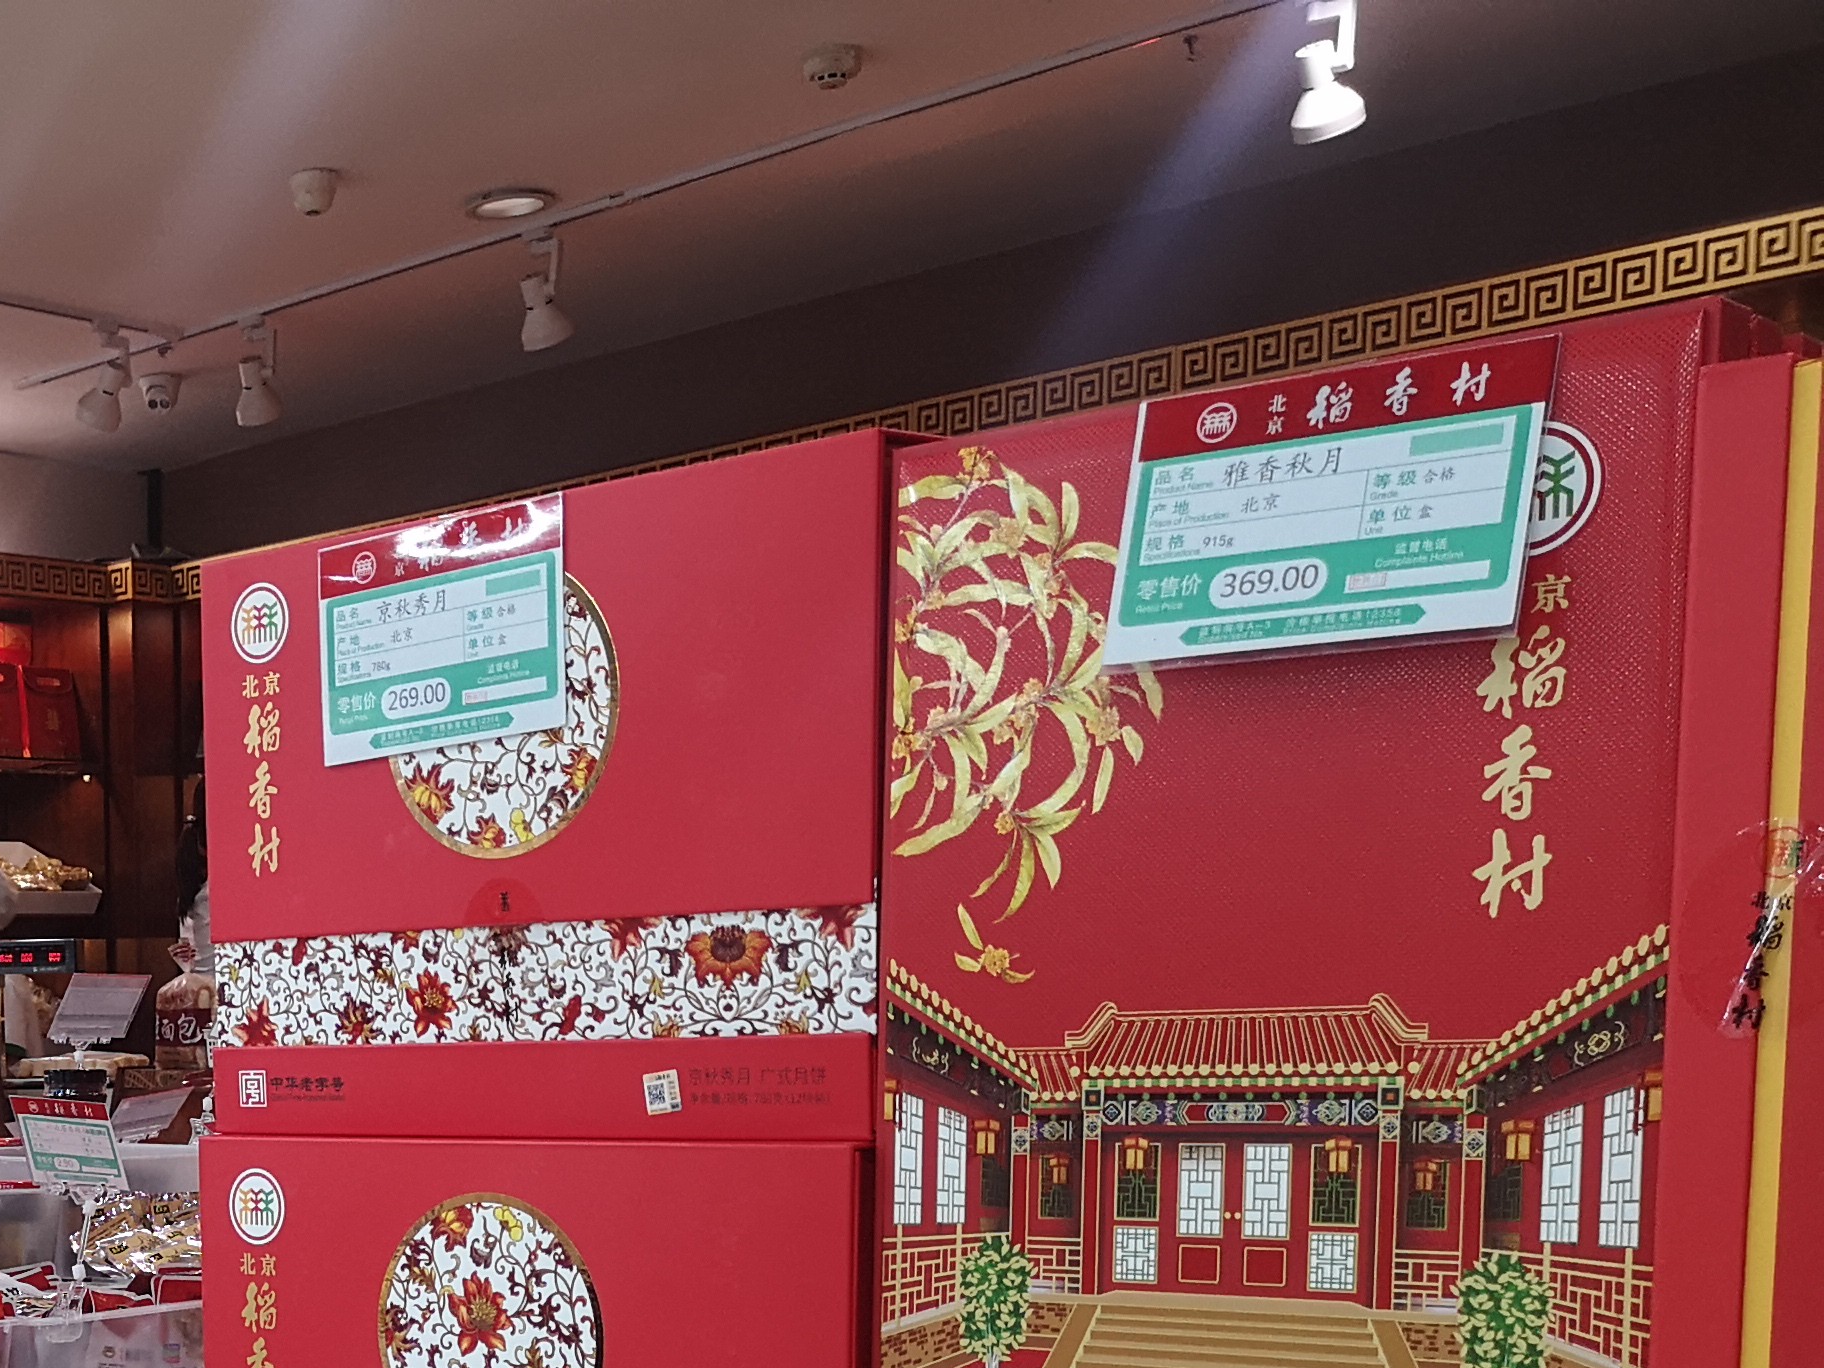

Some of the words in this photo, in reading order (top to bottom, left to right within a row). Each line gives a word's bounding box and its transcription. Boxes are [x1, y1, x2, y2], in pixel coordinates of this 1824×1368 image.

[1265, 394, 1287, 434] 北京
[1306, 361, 1492, 428] 稻香村
[1155, 466, 1195, 485] 品名
[1222, 447, 1342, 488] 雅香秋月
[1373, 469, 1417, 489] 等级
[1424, 466, 1456, 483] 合格
[1149, 500, 1189, 518] 产地
[1241, 493, 1280, 513] 北京
[1367, 505, 1412, 524] 单位
[1145, 534, 1184, 551] 规格
[1202, 536, 1234, 549] 915g
[1137, 573, 1202, 600] 零售价
[1219, 564, 1319, 598] 369.00
[376, 588, 446, 623] 京秋秀月
[466, 605, 492, 622] 等级
[337, 634, 360, 649] 产地
[390, 627, 413, 644] 北京
[468, 634, 494, 649] 单位
[337, 660, 361, 676] 规格
[241, 671, 281, 698] 北京
[388, 681, 446, 711] 269.00
[337, 692, 376, 714] 零售价
[1473, 626, 1567, 919] 稻香村
[242, 701, 282, 878] 稻香村
[270, 1077, 344, 1092] 中华老字号
[240, 1252, 276, 1276] 北京
